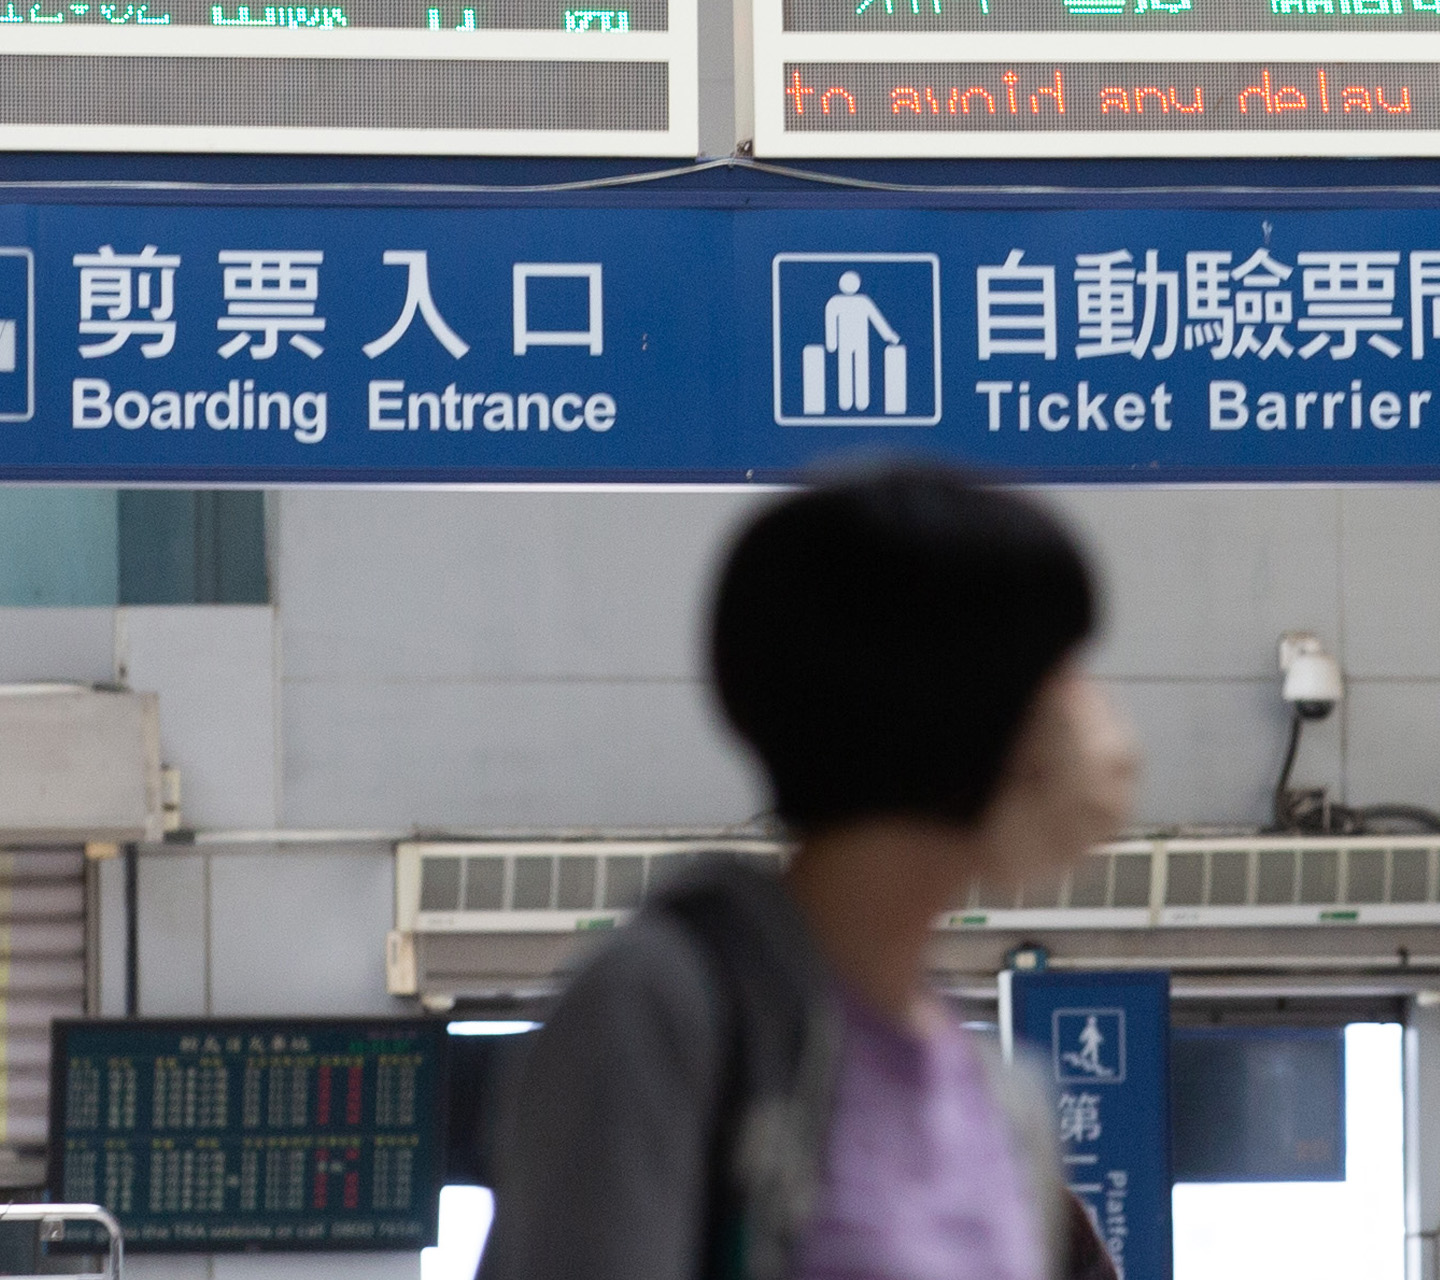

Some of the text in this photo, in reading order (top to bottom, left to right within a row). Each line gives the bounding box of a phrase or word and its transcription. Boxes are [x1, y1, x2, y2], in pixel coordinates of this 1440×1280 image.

[72, 244, 604, 360] 剪票入口
[72, 377, 617, 444] Boarding Entrance
[975, 379, 1432, 432] Ticket Barrier
